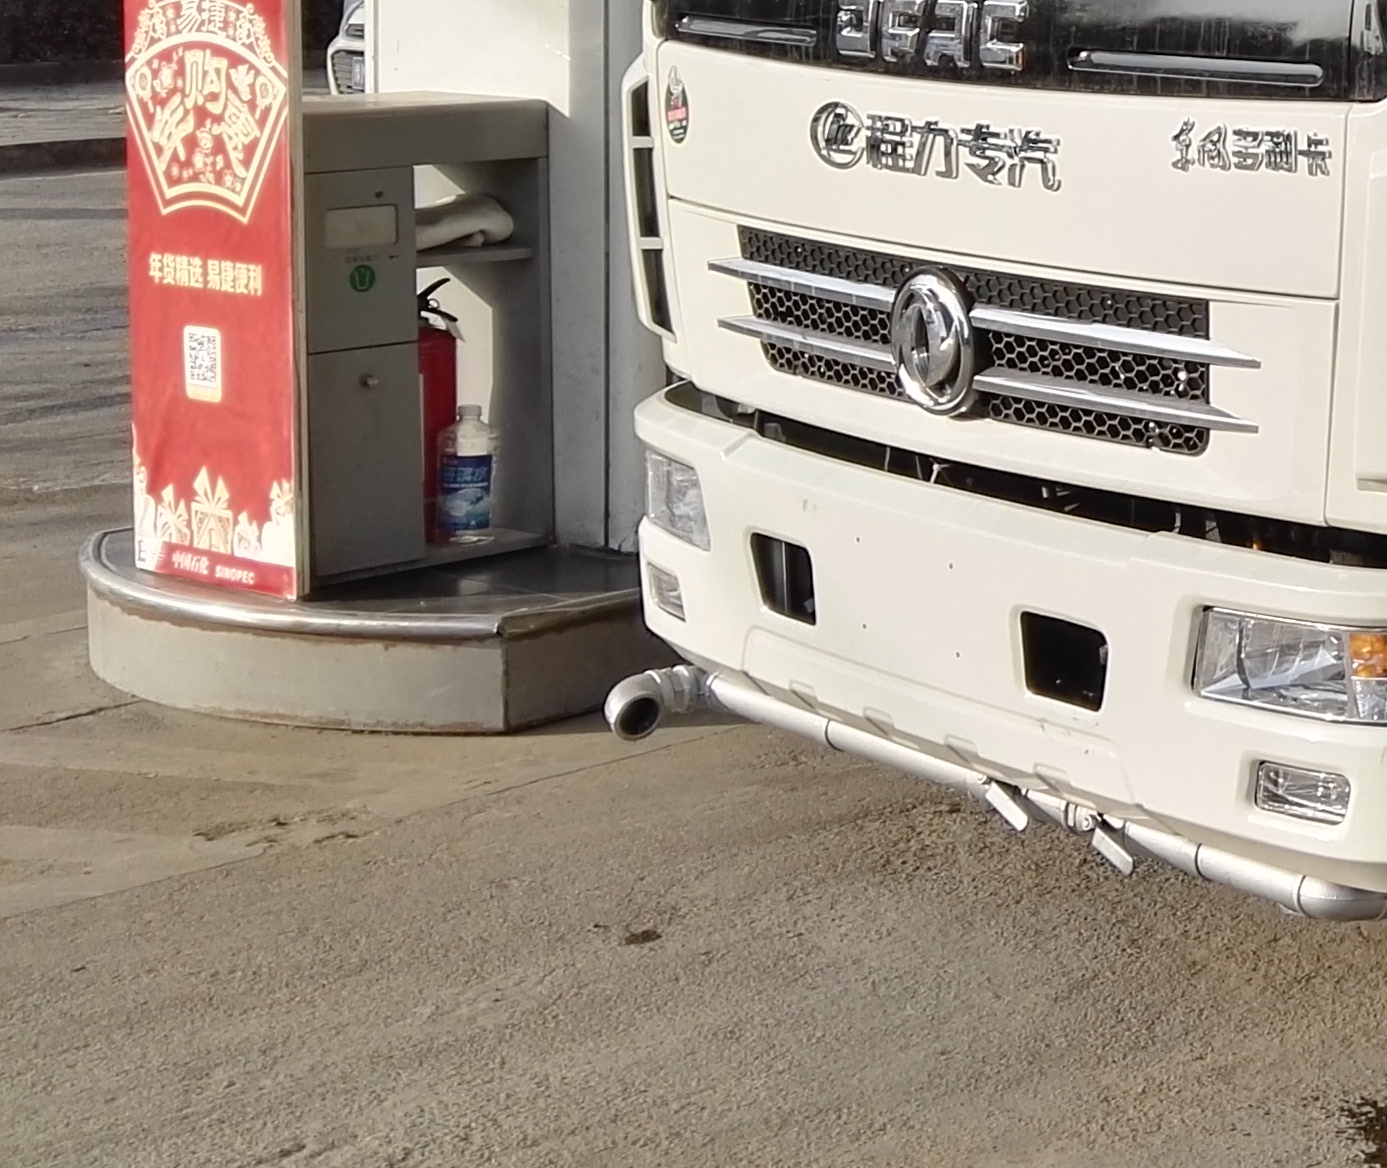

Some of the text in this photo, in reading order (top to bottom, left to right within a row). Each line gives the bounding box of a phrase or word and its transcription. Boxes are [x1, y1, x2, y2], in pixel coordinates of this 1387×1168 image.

[865, 113, 1062, 192] 程力专汽
[148, 251, 263, 296] 年货精选 易捷便利
[214, 565, 256, 585] SINOPEC
